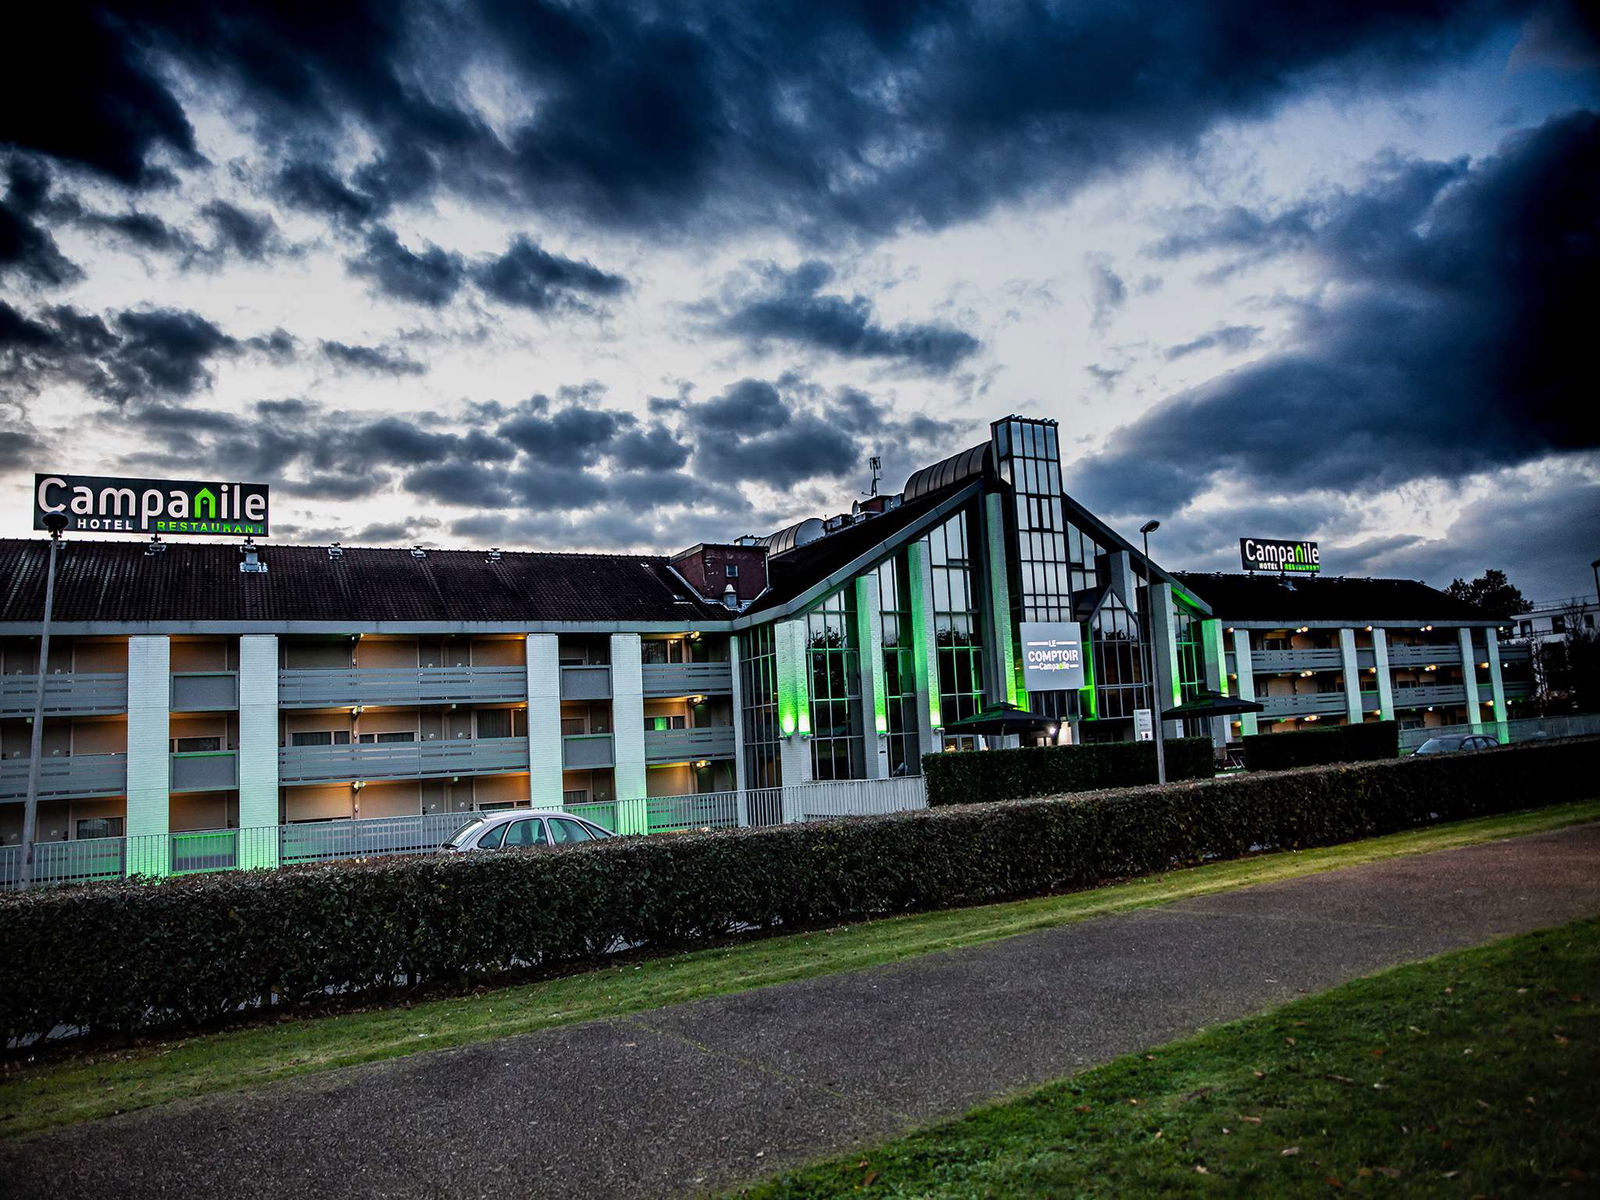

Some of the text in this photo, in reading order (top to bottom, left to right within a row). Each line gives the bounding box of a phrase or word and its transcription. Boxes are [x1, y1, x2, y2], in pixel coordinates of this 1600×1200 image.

[38, 477, 265, 530] Campanile
[77, 519, 264, 534] HOTEL RESTAURANT
[1246, 540, 1319, 569] Campanile
[1259, 562, 1278, 570] HOTEL
[1028, 650, 1078, 662] COMPTOIR
